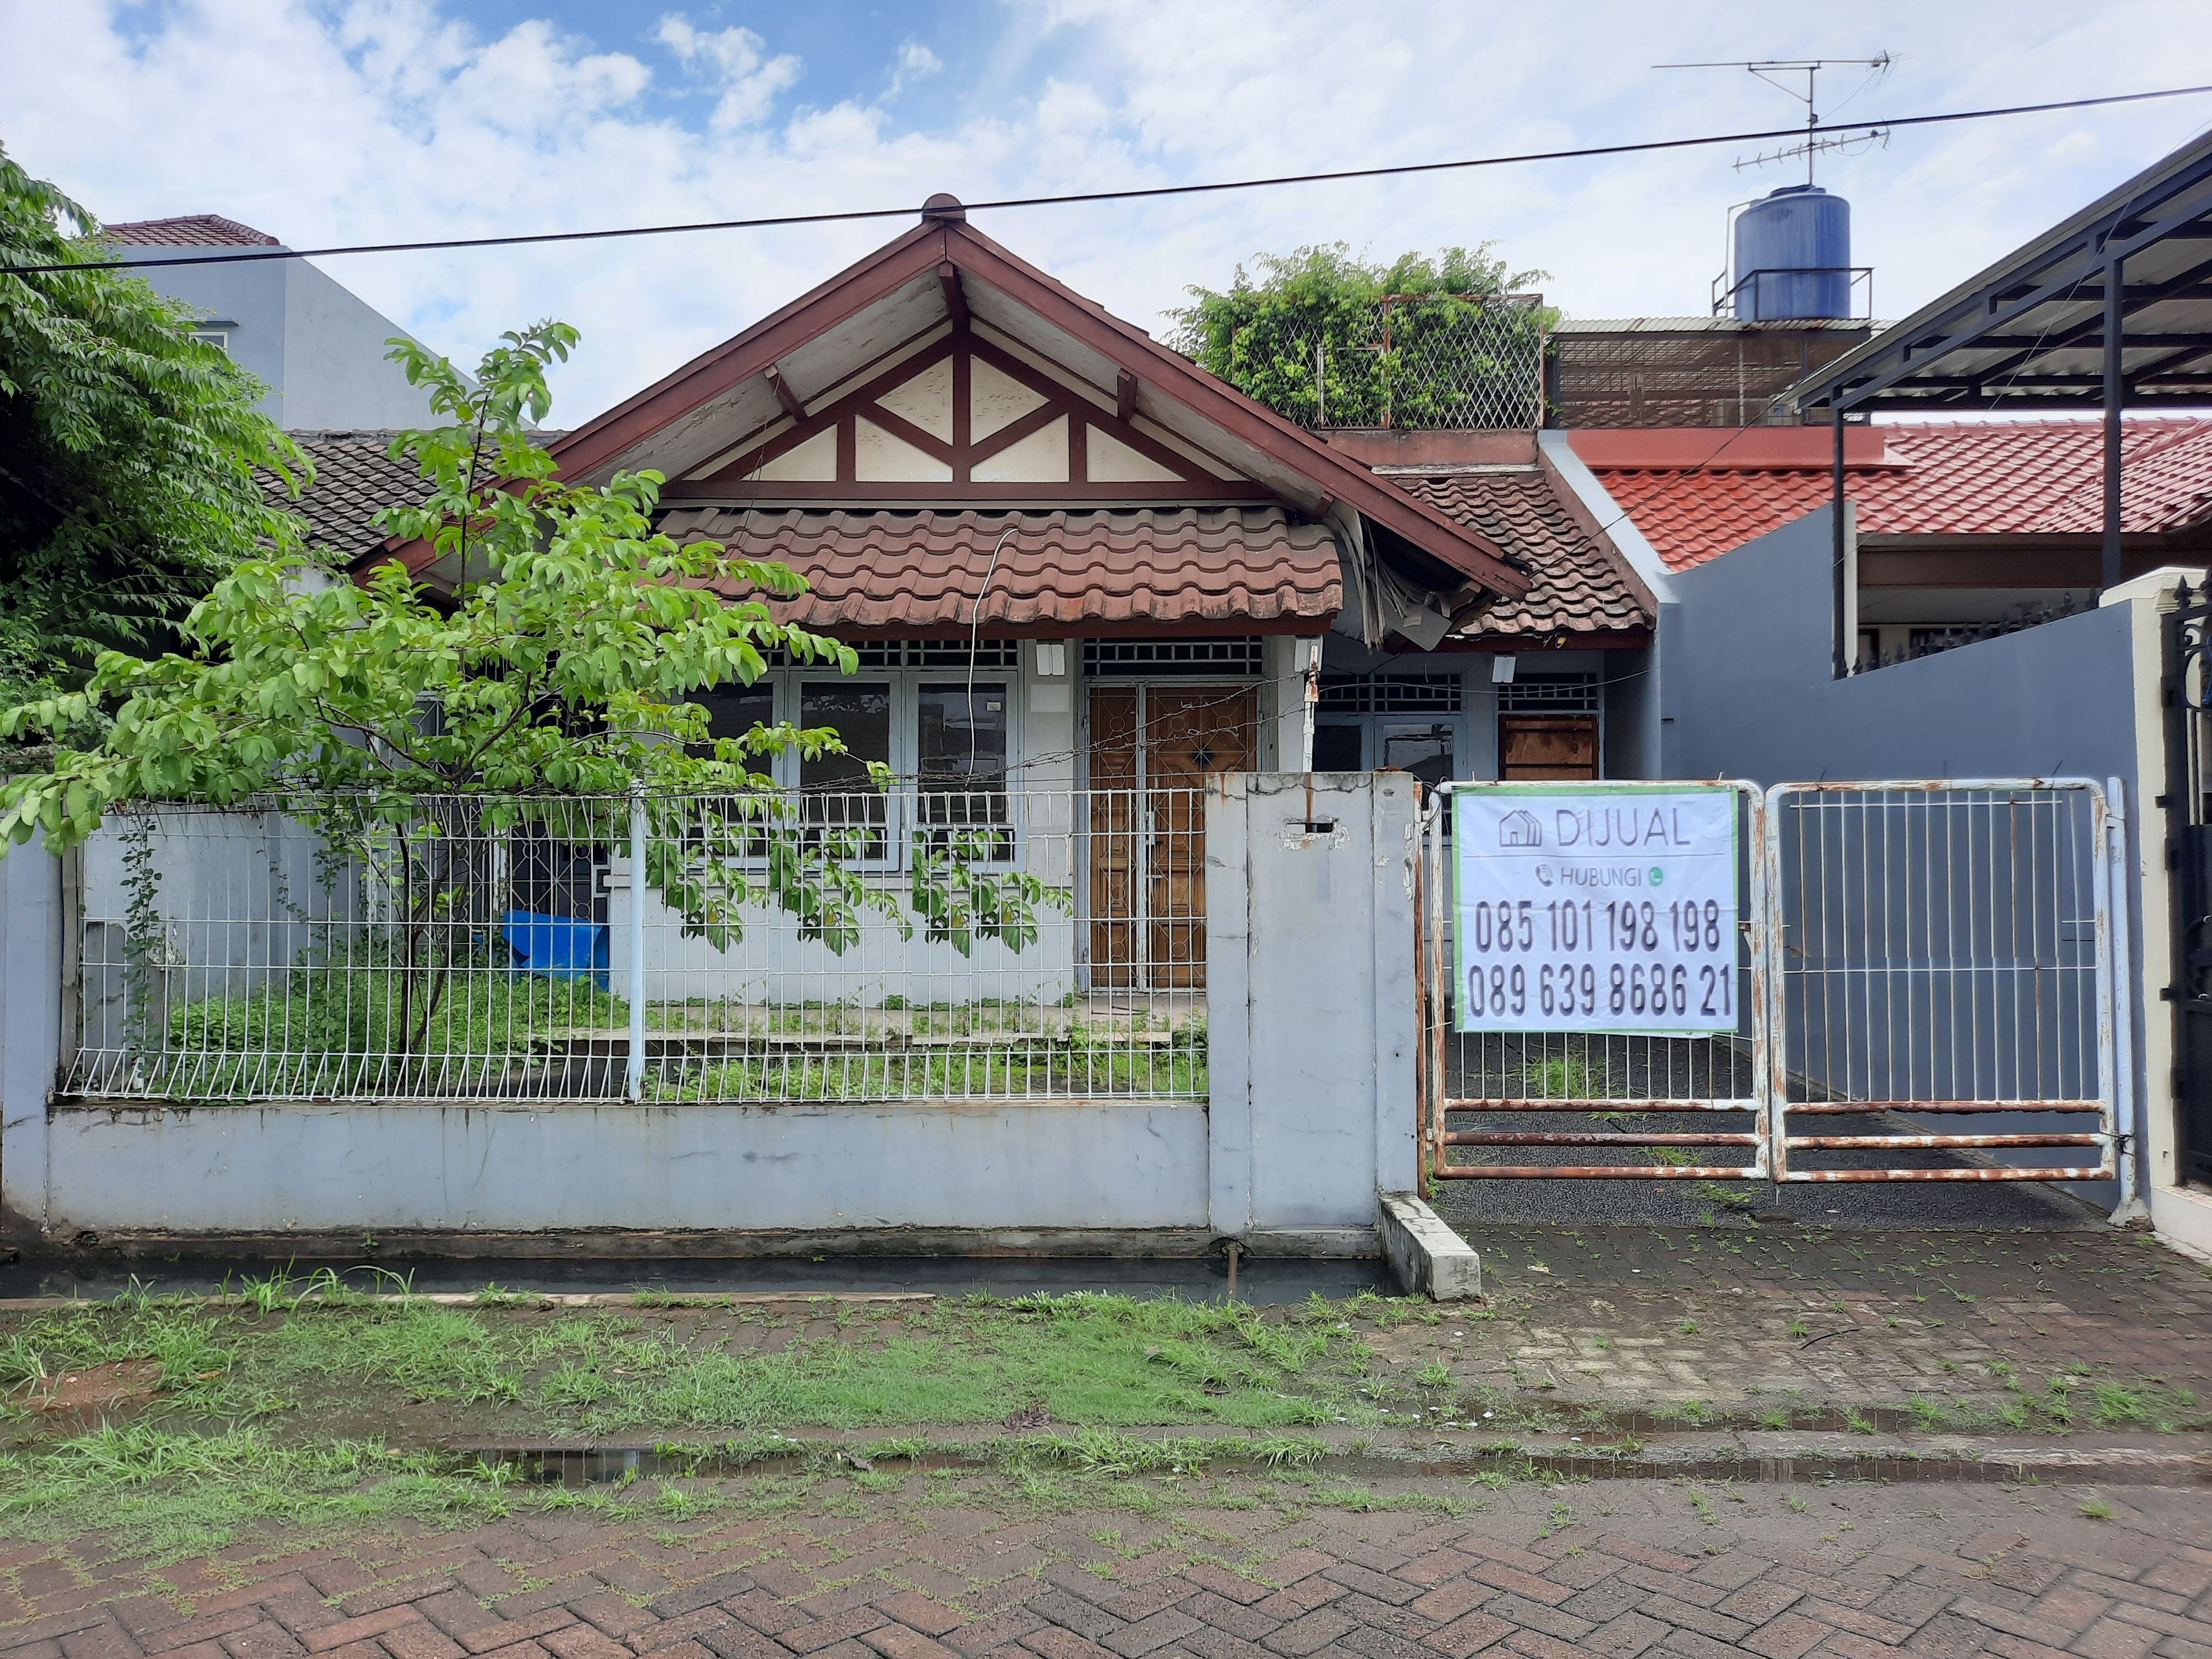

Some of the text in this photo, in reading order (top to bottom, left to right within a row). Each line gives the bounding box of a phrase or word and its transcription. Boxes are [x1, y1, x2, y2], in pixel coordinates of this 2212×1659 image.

[1556, 807, 1691, 847] DIJUAL
[1560, 867, 1642, 886] HUBUNGI
[1475, 899, 1720, 953] 085 101 198 198
[1468, 963, 1730, 1017] 089 639 8686 21
